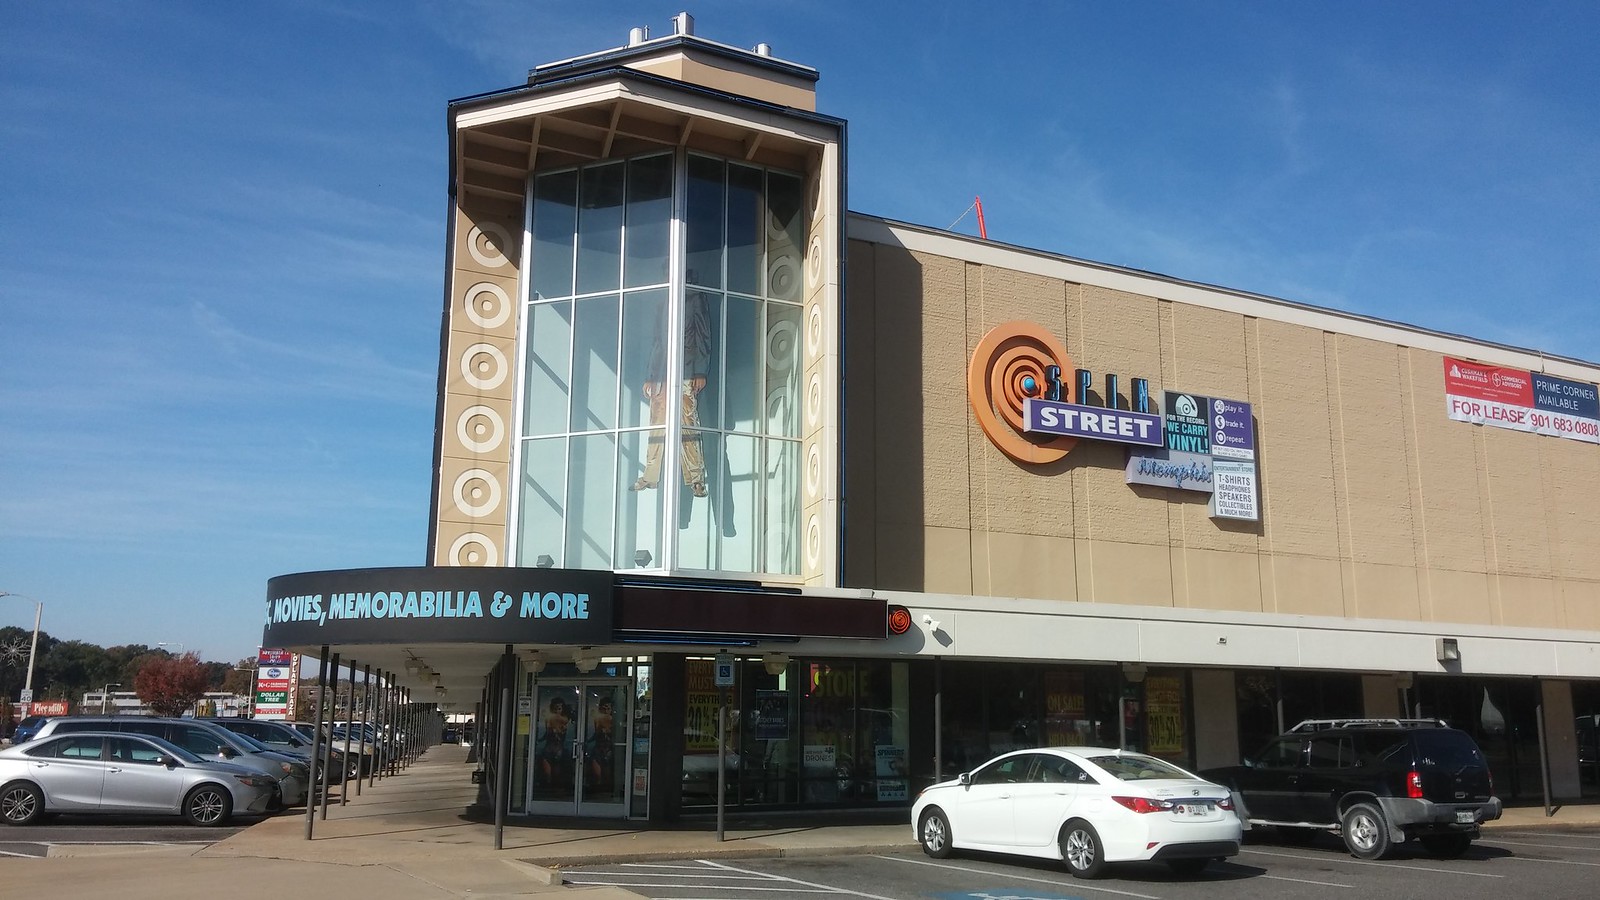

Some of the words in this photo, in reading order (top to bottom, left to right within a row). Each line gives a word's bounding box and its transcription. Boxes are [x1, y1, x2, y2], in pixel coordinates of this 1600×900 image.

[1461, 368, 1483, 376] CUSHMAN
[1461, 374, 1488, 383] WAKEFIELD
[1501, 375, 1527, 385] COMMERCIAL
[1501, 381, 1522, 389] ADVISORS
[1045, 365, 1150, 413] SPIN
[1536, 380, 1561, 394] PRIME
[1562, 385, 1596, 401] CORNER
[1538, 394, 1579, 411] AVAILABLE
[1225, 405, 1237, 414] play
[1040, 407, 1153, 439] STREET
[1225, 420, 1239, 428] trade
[1452, 399, 1481, 417] FOR
[1484, 405, 1526, 424] LEASE
[1530, 413, 1550, 429] 901
[1553, 417, 1573, 433] 683
[1574, 420, 1599, 437] 0808
[1167, 421, 1180, 433] WE
[1181, 423, 1208, 436] CARRY
[1168, 433, 1209, 454] VINYL!
[1138, 457, 1213, 488] Memphis
[1218, 474, 1251, 486] T-SHIRTS
[1218, 484, 1251, 493] HEADPHONES
[1218, 492, 1252, 503] SPEAKERS
[1218, 501, 1253, 510] COLLECTIBLES
[273, 594, 327, 627] MOVIES,
[329, 591, 484, 620] MEMORABILIA
[490, 590, 512, 618] &
[520, 591, 589, 620] MORE
[290, 653, 298, 684] OPLAR
[815, 670, 869, 697] STORE
[288, 687, 296, 716] PLAZA
[689, 694, 732, 704] EVERYTHG
[805, 754, 833, 762] DRONES!
